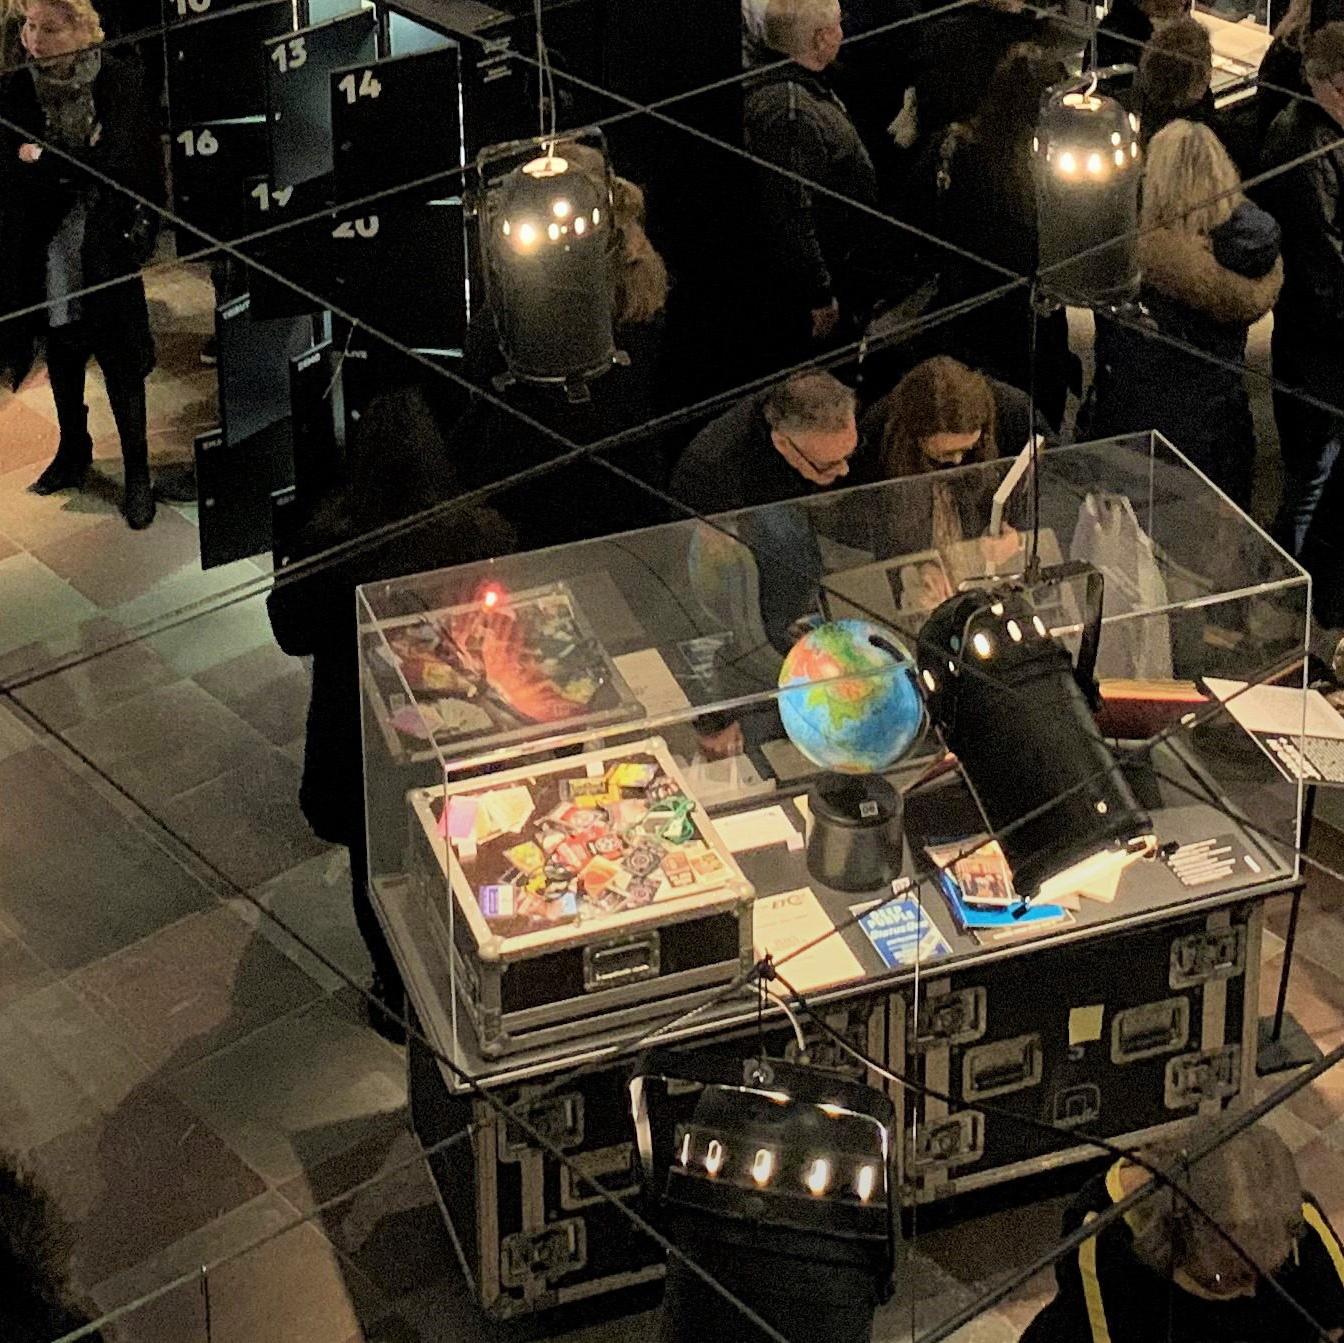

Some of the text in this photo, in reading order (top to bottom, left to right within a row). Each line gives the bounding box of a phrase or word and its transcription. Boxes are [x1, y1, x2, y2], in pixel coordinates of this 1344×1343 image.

[271, 37, 307, 73] 13
[338, 70, 382, 104] 14
[177, 129, 219, 156] 16
